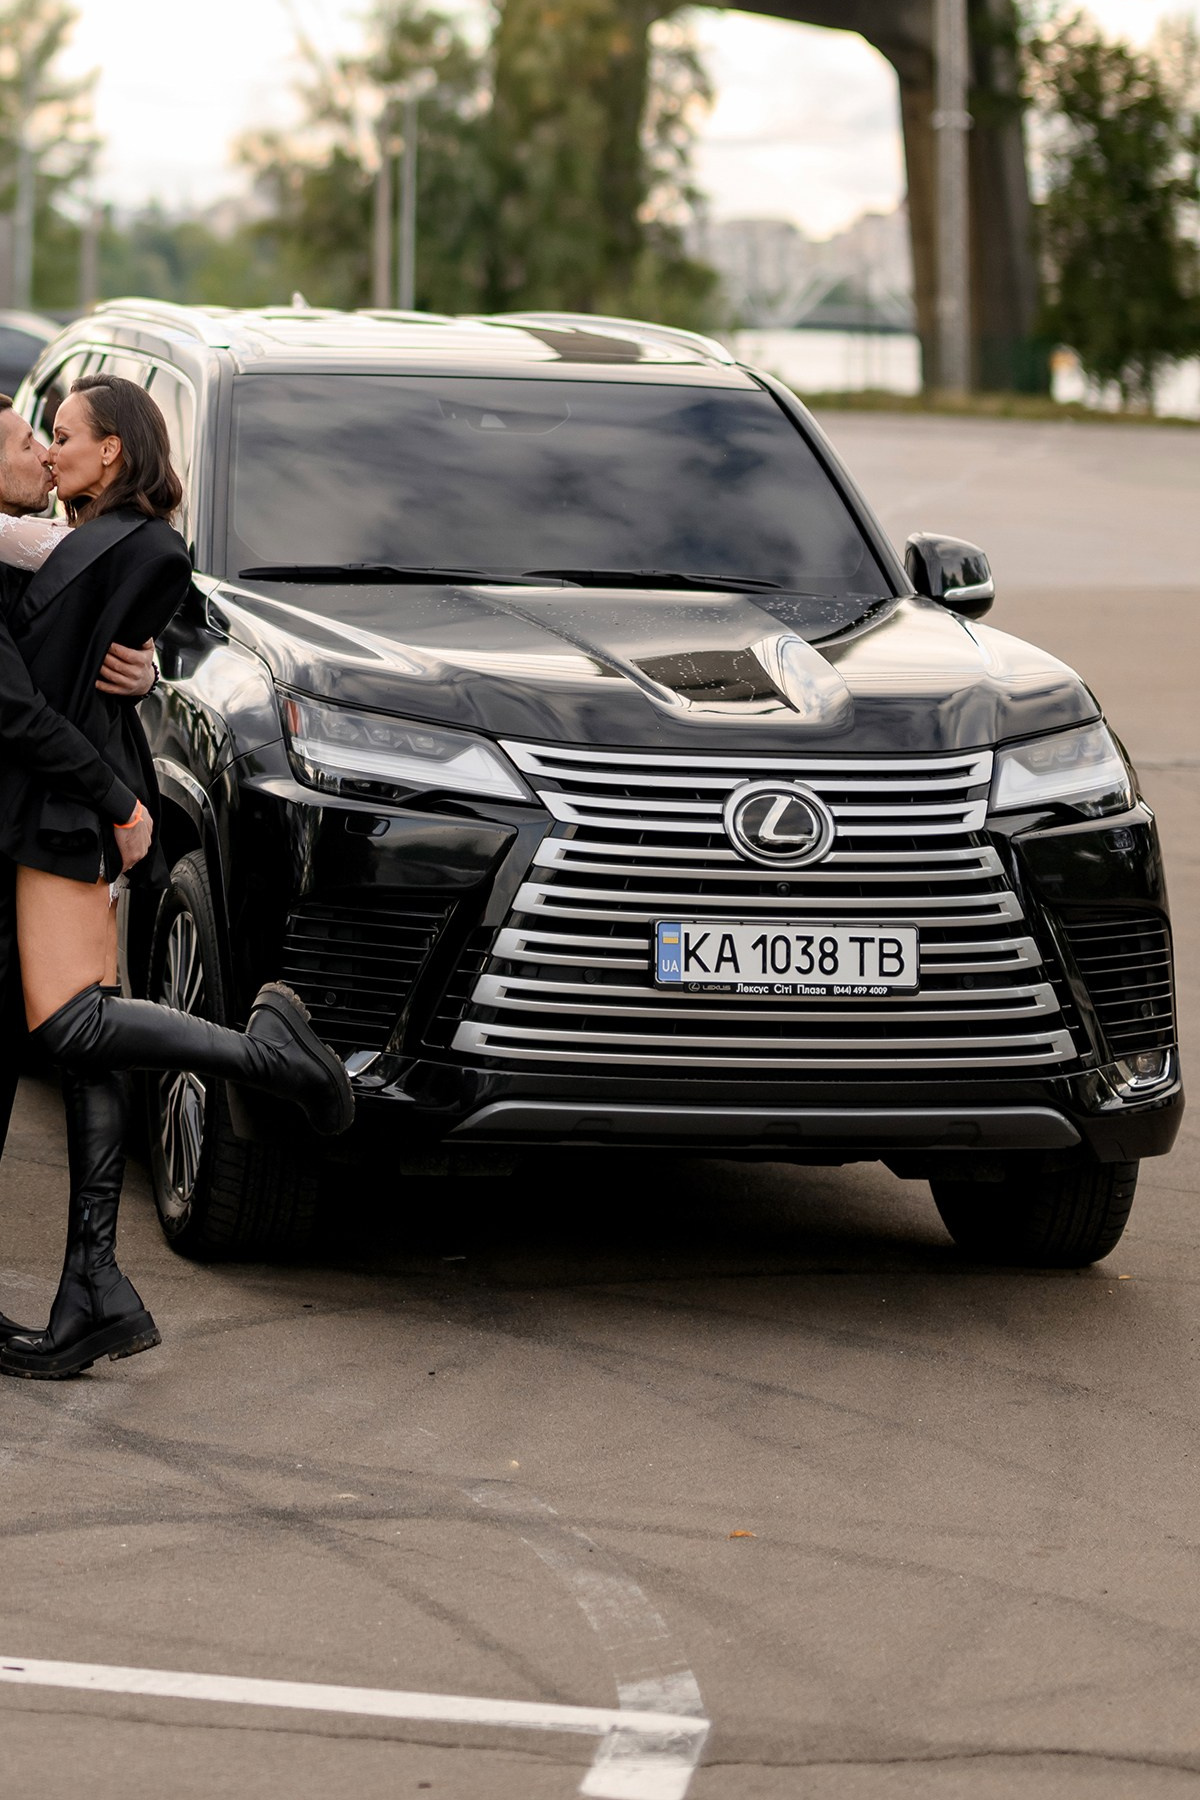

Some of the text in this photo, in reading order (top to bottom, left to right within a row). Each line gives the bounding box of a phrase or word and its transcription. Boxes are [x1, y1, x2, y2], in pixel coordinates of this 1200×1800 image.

[683, 932, 905, 977] KA 1038 TB
[662, 959, 680, 973] UA
[736, 983, 888, 996] Лексус Сіті Плаза (044) 499 4009
